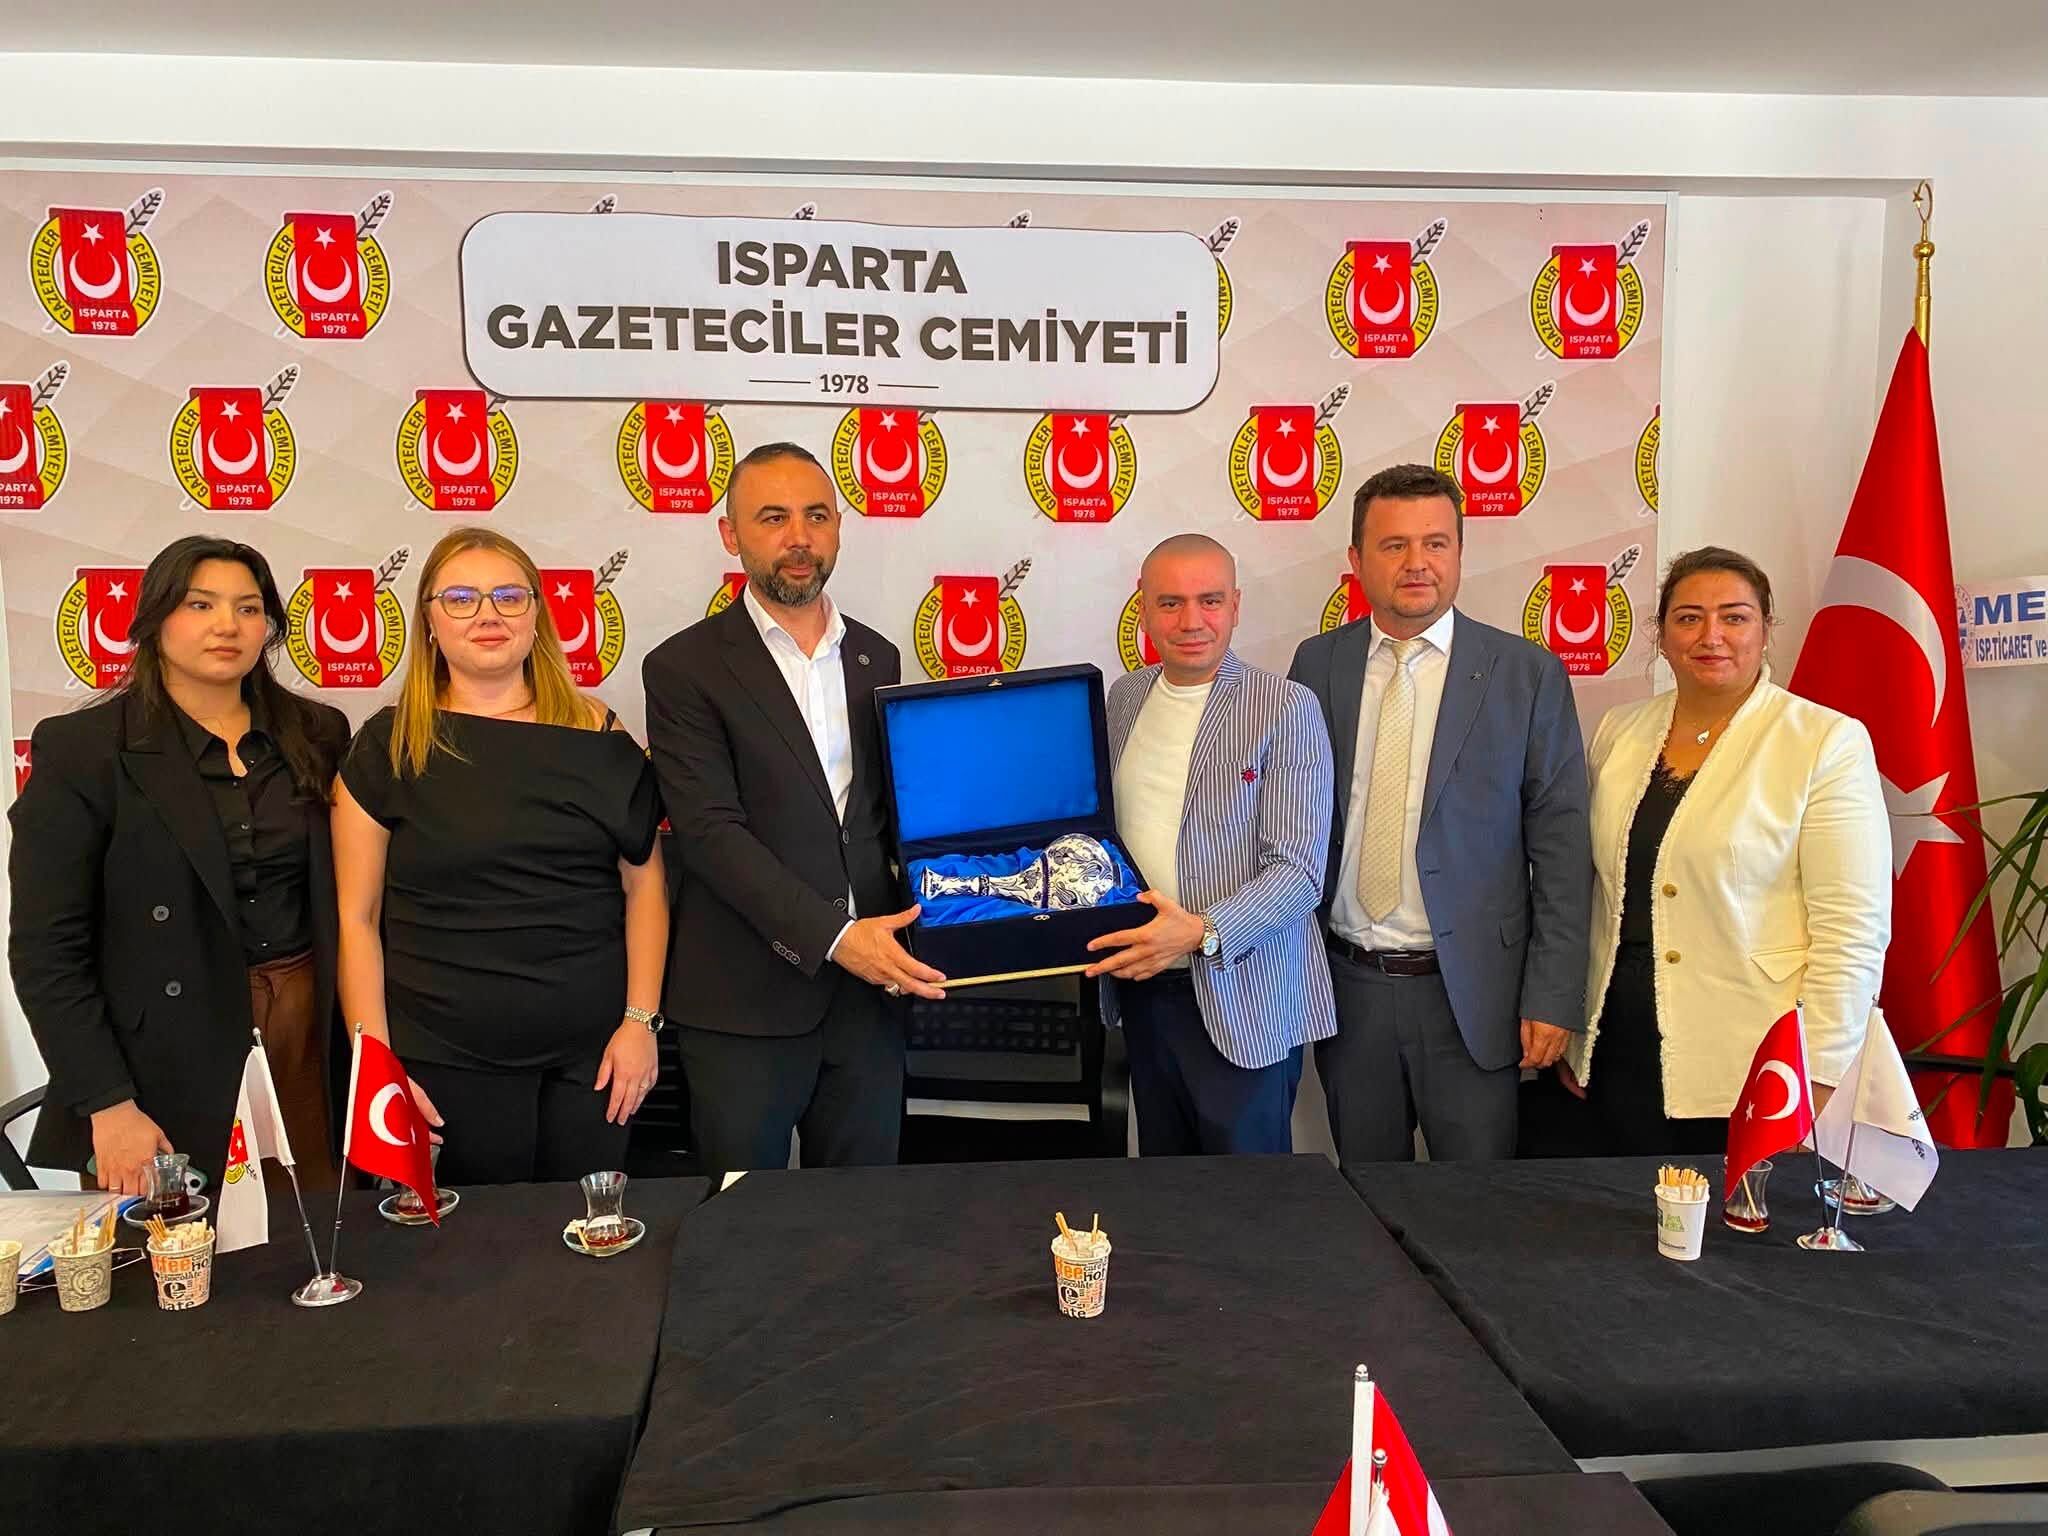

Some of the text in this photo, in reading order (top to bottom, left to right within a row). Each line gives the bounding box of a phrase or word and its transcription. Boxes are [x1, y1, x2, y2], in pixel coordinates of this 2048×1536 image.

[35, 227, 72, 322] GAZETECİLER
[133, 242, 158, 312] CEMİYETİ
[267, 233, 303, 326] GAZETECİLER
[364, 245, 386, 315] CEMİYETİ
[717, 241, 968, 294] ISPARTA
[79, 308, 130, 320] ISPARTA
[91, 320, 118, 331] 1978
[310, 312, 359, 323] ISPARTA
[322, 324, 347, 335] 1978
[487, 300, 1188, 364] GAZETECİLER CEMİYETİ
[1328, 262, 1358, 347] GAZETECİLER
[1417, 270, 1436, 335] CEMİYETİ
[1534, 265, 1562, 348] GAZETECİLER
[1622, 272, 1641, 338] CEMİYETİ
[1364, 334, 1408, 344] ISPARTA
[1374, 345, 1397, 354] 1978
[1569, 334, 1613, 344] ISPARTA
[1579, 346, 1602, 355] 1978
[820, 374, 869, 393] 1978
[40, 415, 63, 486] CEMİYETİ
[175, 407, 209, 499] GAZETECİLER
[269, 417, 292, 486] CEMİYETİ
[401, 409, 434, 499] GAZETECİLER
[493, 420, 513, 489] CEMİYETİ
[620, 412, 653, 501] GAZETECİLER
[710, 423, 733, 491] CEMİYETİ
[836, 417, 866, 505] GAZETECİLER
[923, 429, 942, 496] CEMİYETİ
[1028, 424, 1057, 510] GAZETECİLER
[1113, 433, 1133, 500] CEMİYETİ
[1232, 426, 1261, 509] GAZETECİLER
[1319, 434, 1340, 497] CEMİYETİ
[1524, 431, 1544, 494] CEMİYETİ
[1641, 424, 1660, 506] AZETECİLER
[0, 483, 36, 493] PARTA
[215, 484, 265, 495] ISPARTA
[228, 496, 253, 506] 1978
[440, 485, 488, 495] ISPARTA
[452, 497, 476, 507] 1978
[659, 487, 705, 497] ISPARTA
[670, 499, 694, 509] 1978
[872, 492, 917, 503] ISPARTA
[884, 504, 906, 513] 1978
[1063, 497, 1107, 507] ISPARTA
[1073, 509, 1096, 518] 1978
[1267, 496, 1311, 506] ISPARTA
[1277, 507, 1300, 516] 1978
[1472, 492, 1516, 501] ISPARTA
[1481, 503, 1504, 512] 1978
[62, 589, 94, 677] GAZETECİLER
[291, 590, 320, 676] GAZETECİLER
[381, 598, 402, 665] CEMİYETİ
[601, 599, 622, 665] CEMİYETİ
[918, 595, 945, 678] GAZETECİLER
[1004, 604, 1024, 667] CEMİYETİ
[1611, 593, 1630, 654] CEMİYETİ
[101, 663, 128, 672] ISPA
[327, 662, 375, 671] ISPARTA
[338, 674, 363, 683] 1978
[952, 665, 996, 674] ISPARTA
[1568, 663, 1591, 671] 1978
